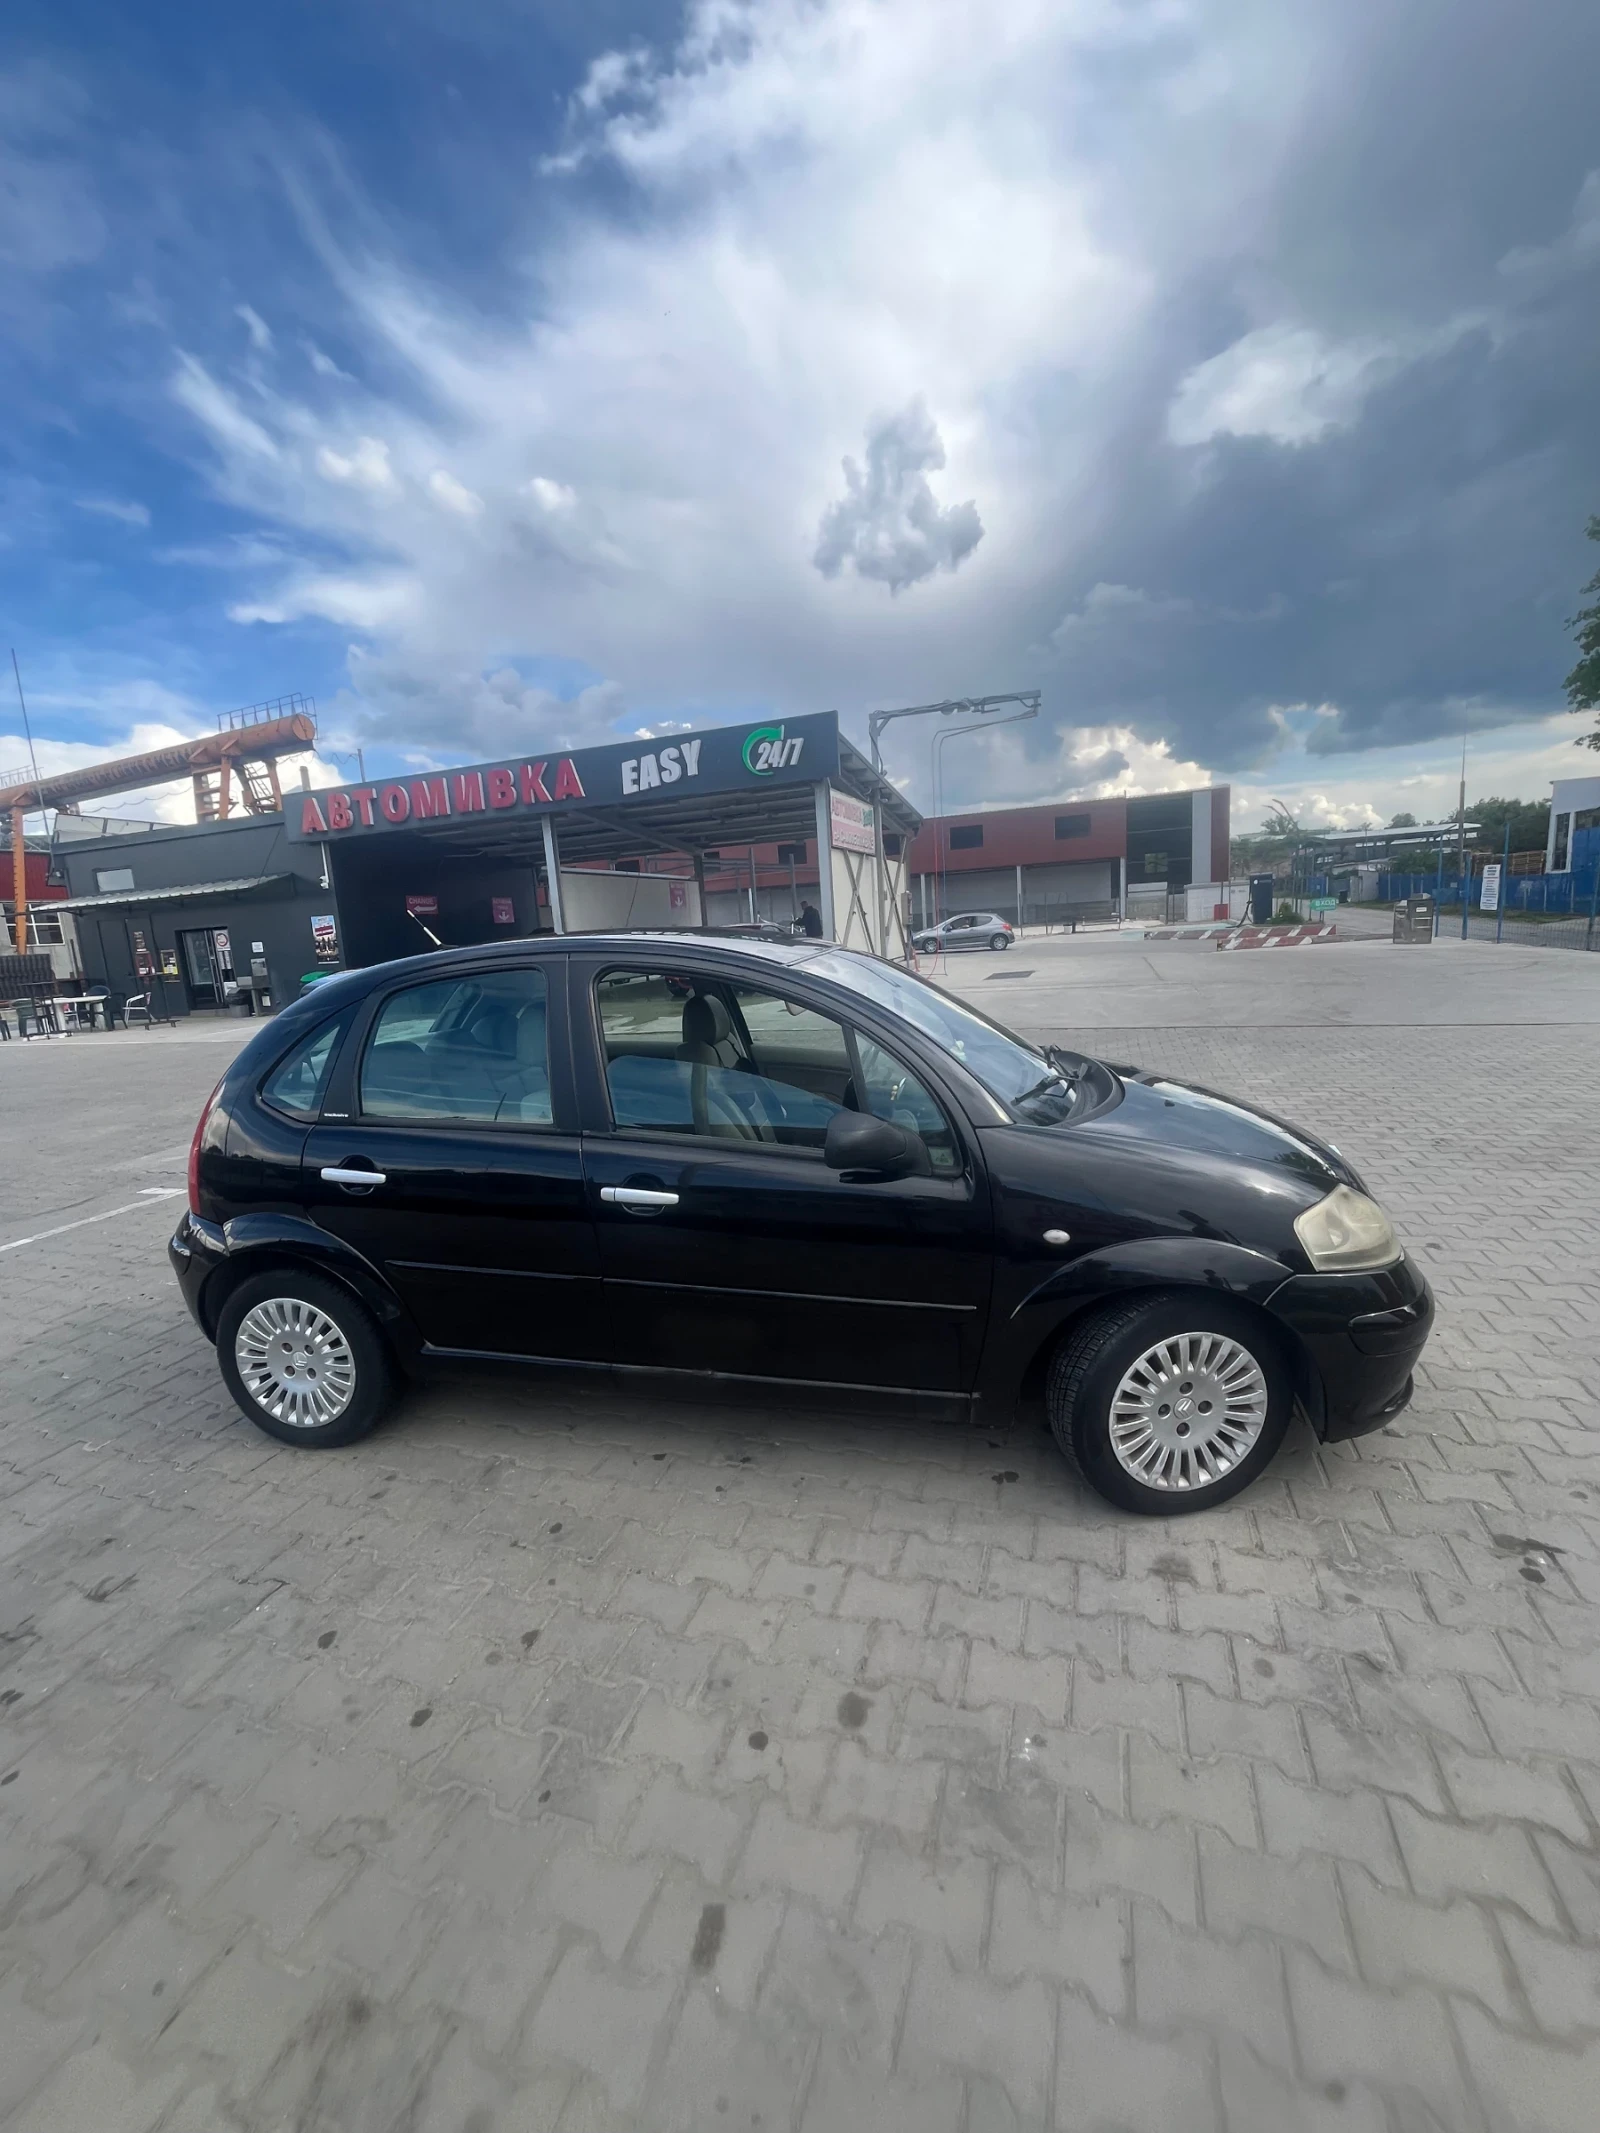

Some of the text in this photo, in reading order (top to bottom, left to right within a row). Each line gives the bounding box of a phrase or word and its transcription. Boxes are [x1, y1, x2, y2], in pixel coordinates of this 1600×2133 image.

[755, 738, 804, 770] 24/7
[302, 739, 702, 834] АВТОМИВКА EASY
[408, 897, 434, 905] CHANGE
